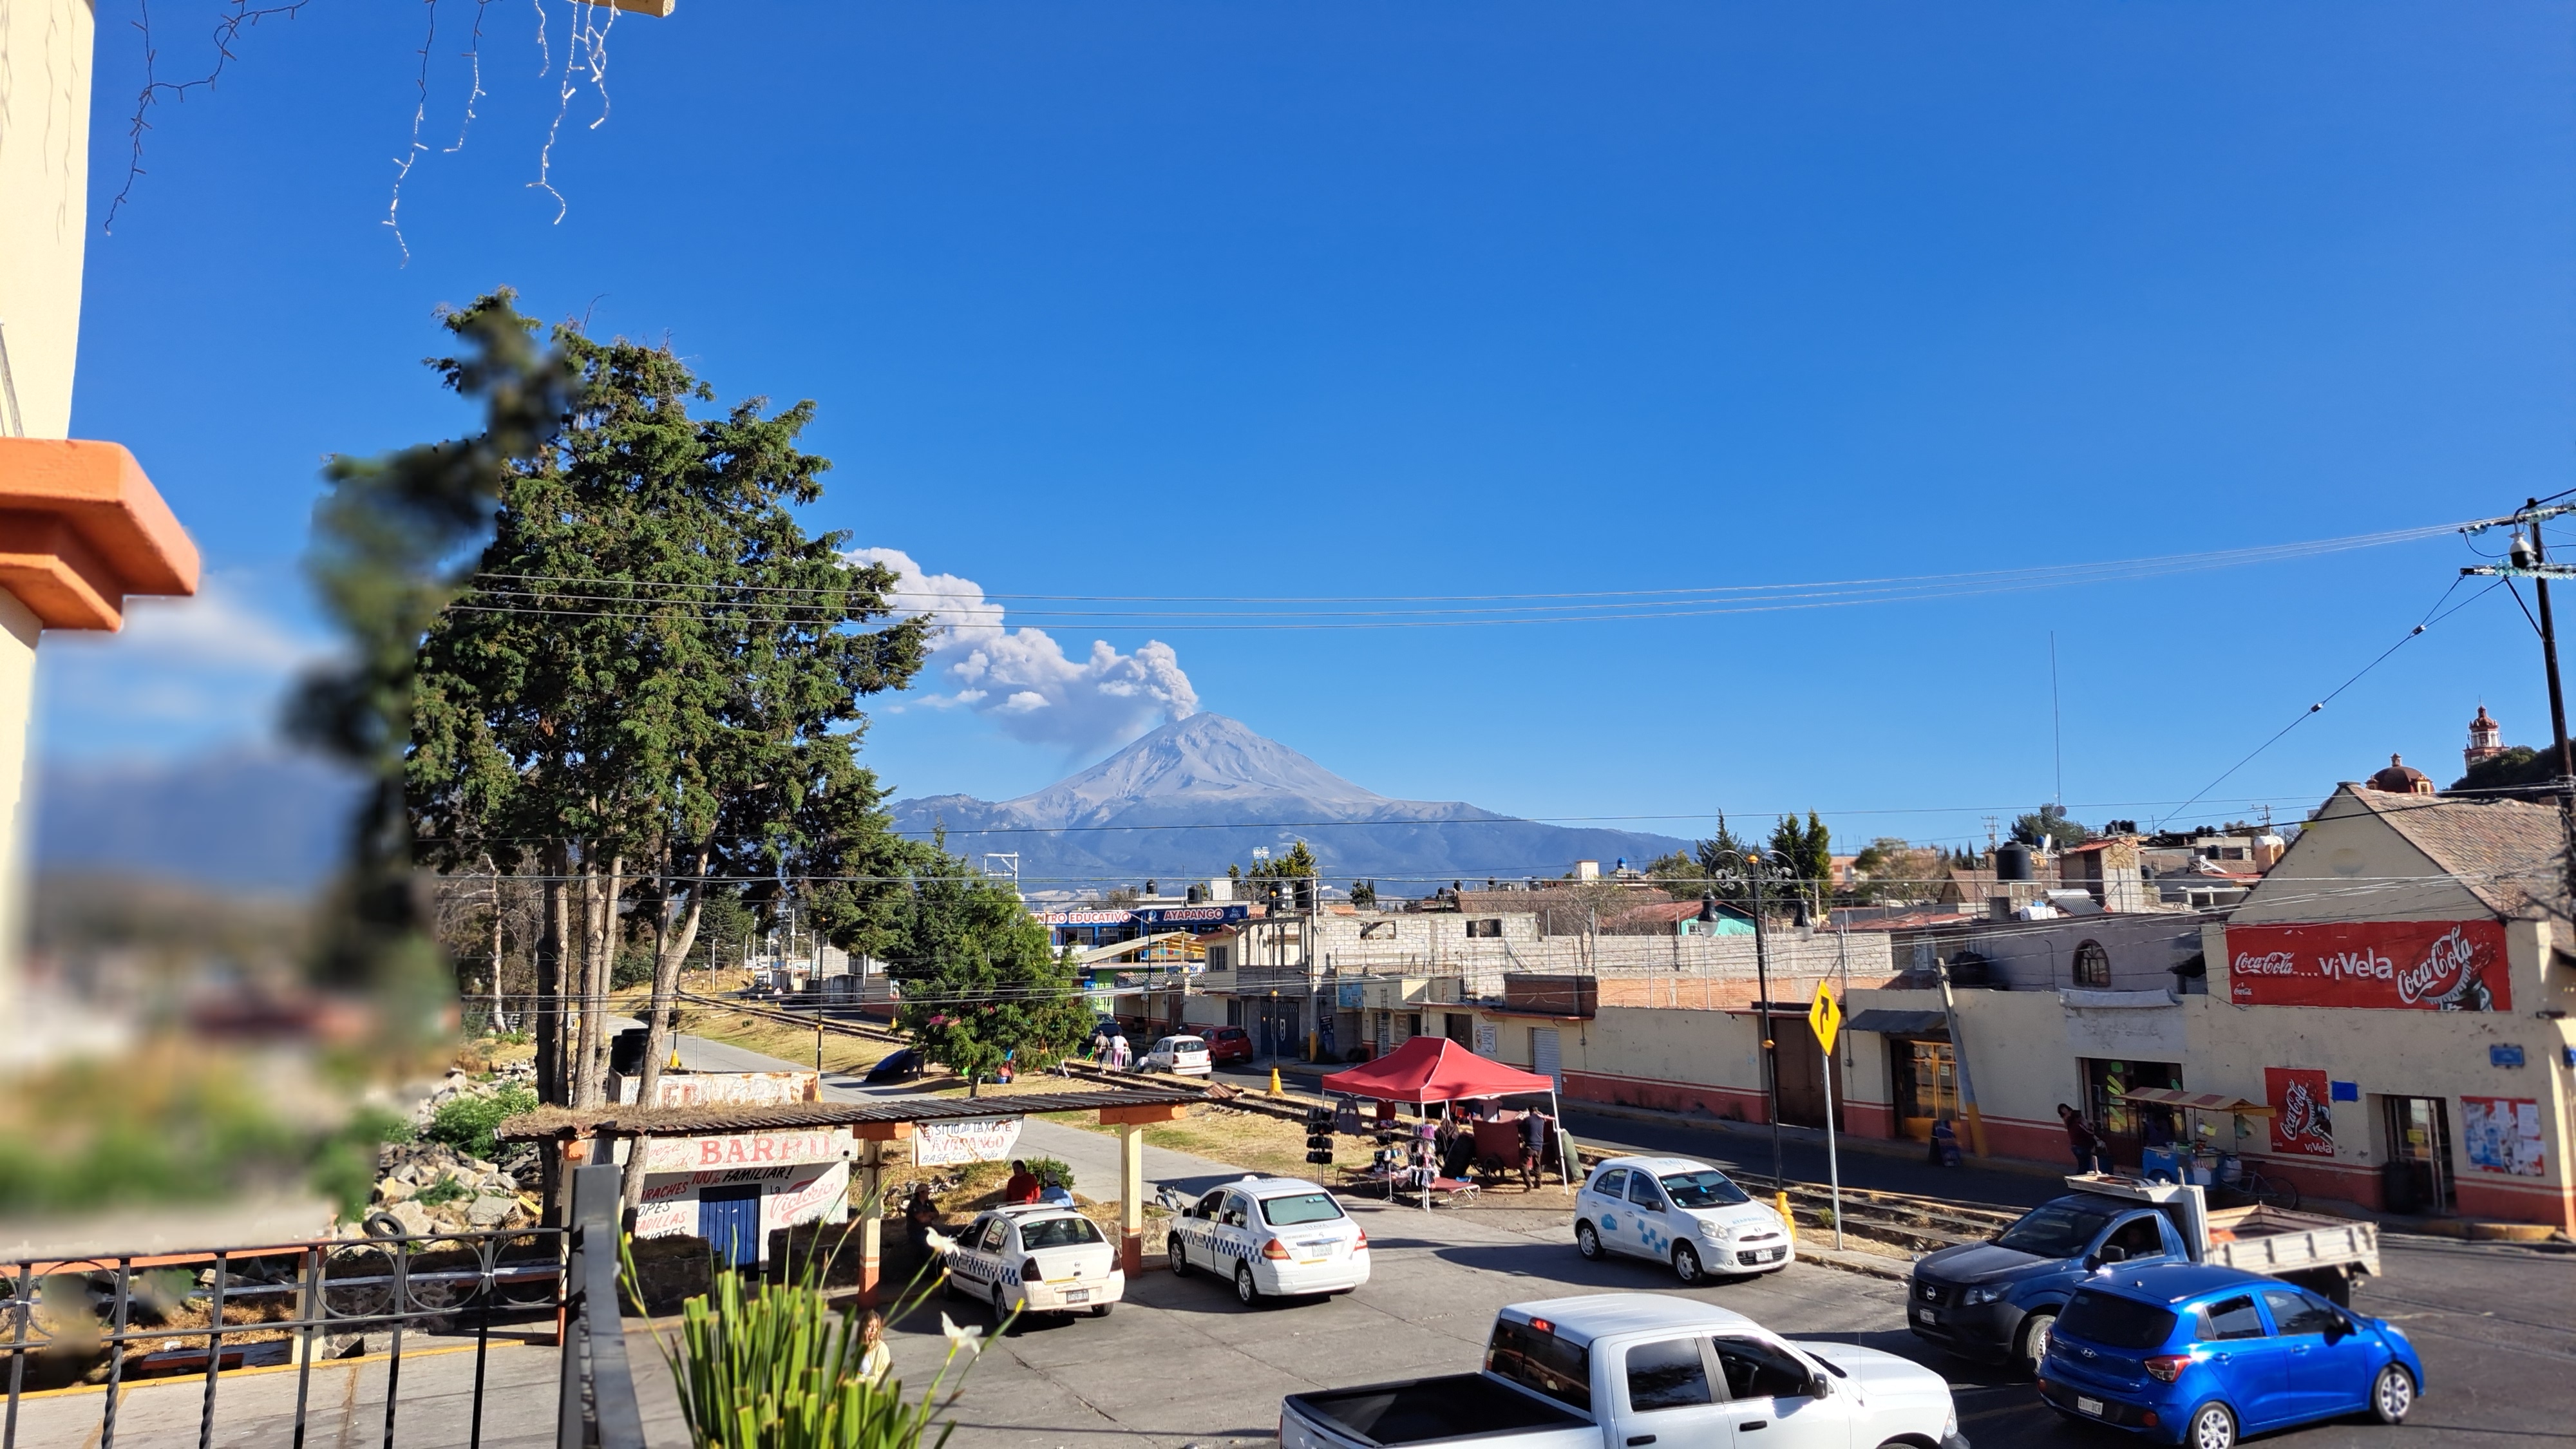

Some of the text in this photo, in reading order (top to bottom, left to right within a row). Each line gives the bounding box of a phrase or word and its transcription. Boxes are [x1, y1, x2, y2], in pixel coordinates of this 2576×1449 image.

[1030, 913, 1067, 924] NTRO
[1069, 911, 1132, 923] EDUCATIVO
[1163, 908, 1224, 921] AYAPANGO
[2235, 951, 2295, 974] Coca-Cola
[2397, 923, 2473, 1004] Coca-Cola
[2280, 1079, 2307, 1141] Coca-Cola
[935, 1123, 960, 1135] SITIO
[647, 1143, 681, 1162] veza
[921, 1153, 949, 1164] BASE
[722, 1166, 794, 1183] FAMILIAR!
[641, 1181, 689, 1202] RACHES
[769, 1175, 837, 1224] Victoria
[770, 1185, 781, 1195] La
[637, 1198, 674, 1217] OPES
